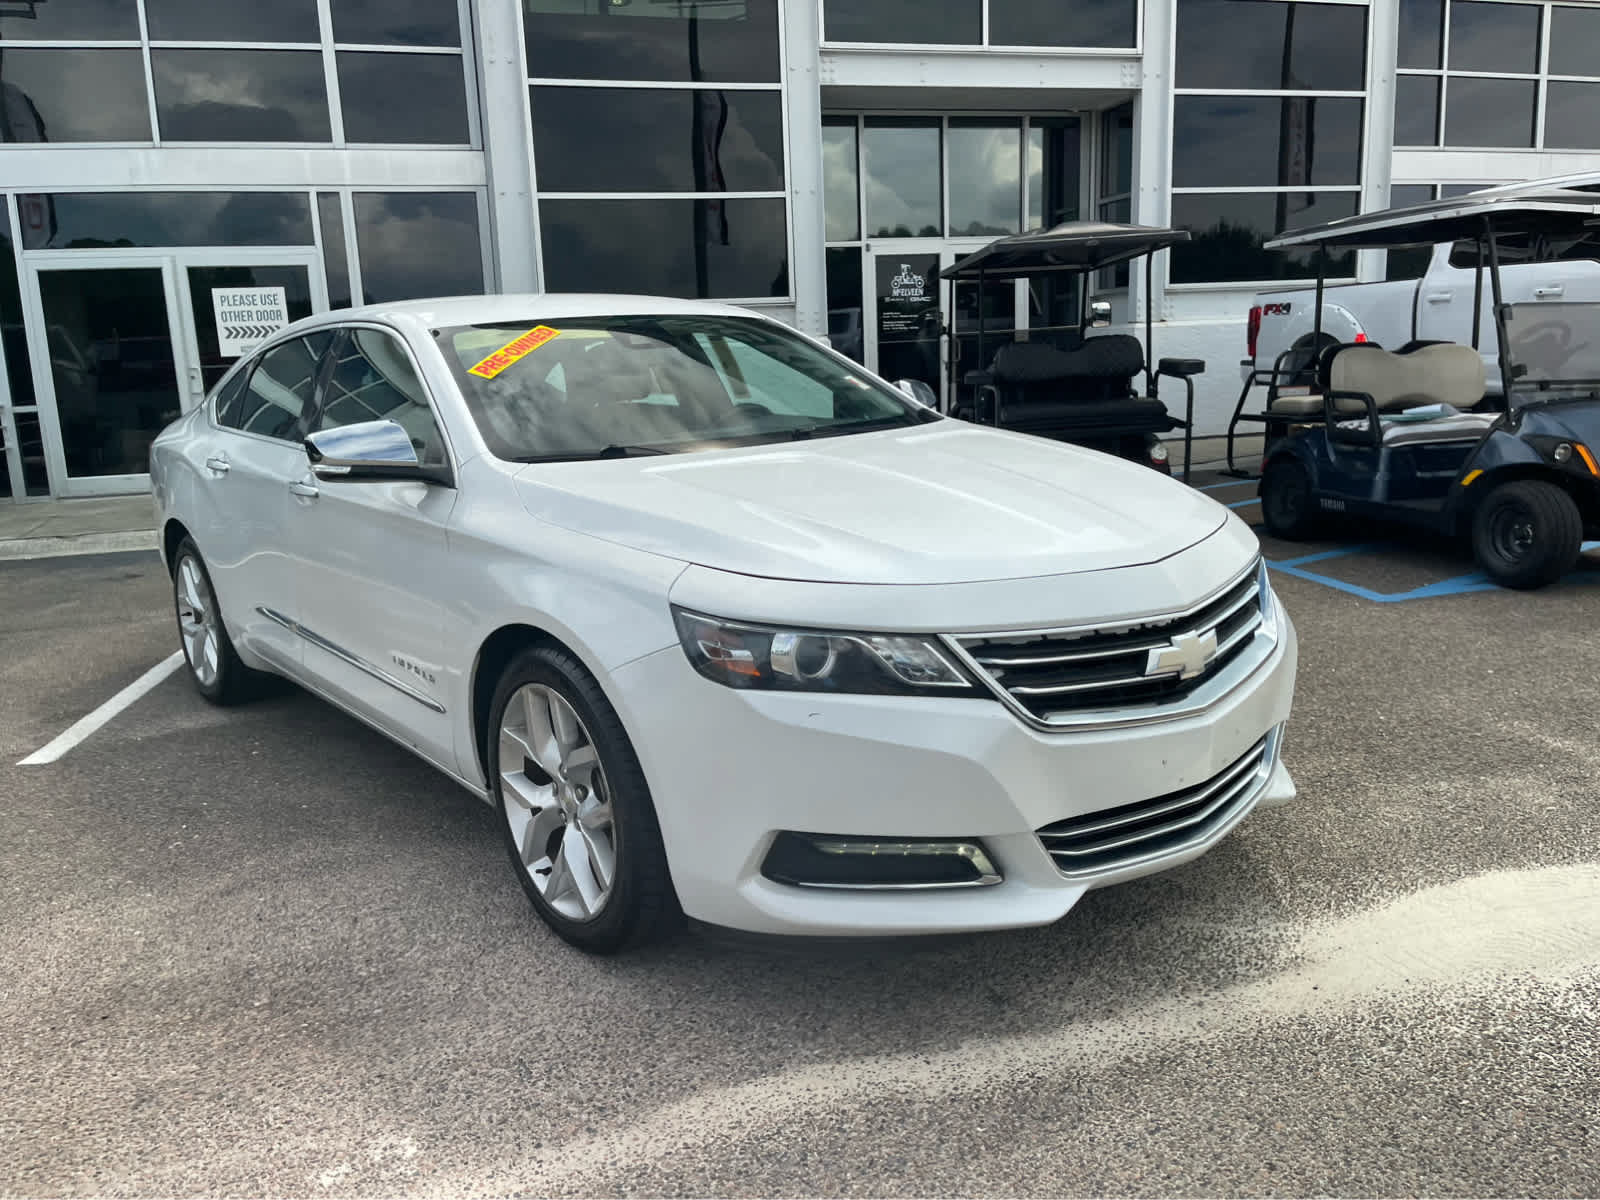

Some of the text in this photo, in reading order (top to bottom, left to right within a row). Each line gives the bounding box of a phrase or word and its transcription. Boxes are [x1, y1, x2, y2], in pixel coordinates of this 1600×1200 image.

[220, 293, 280, 307] PLEASE USE
[221, 309, 282, 322] OTHER DOOR
[1264, 302, 1291, 316] FX4
[475, 327, 554, 376] PRE-OWNED
